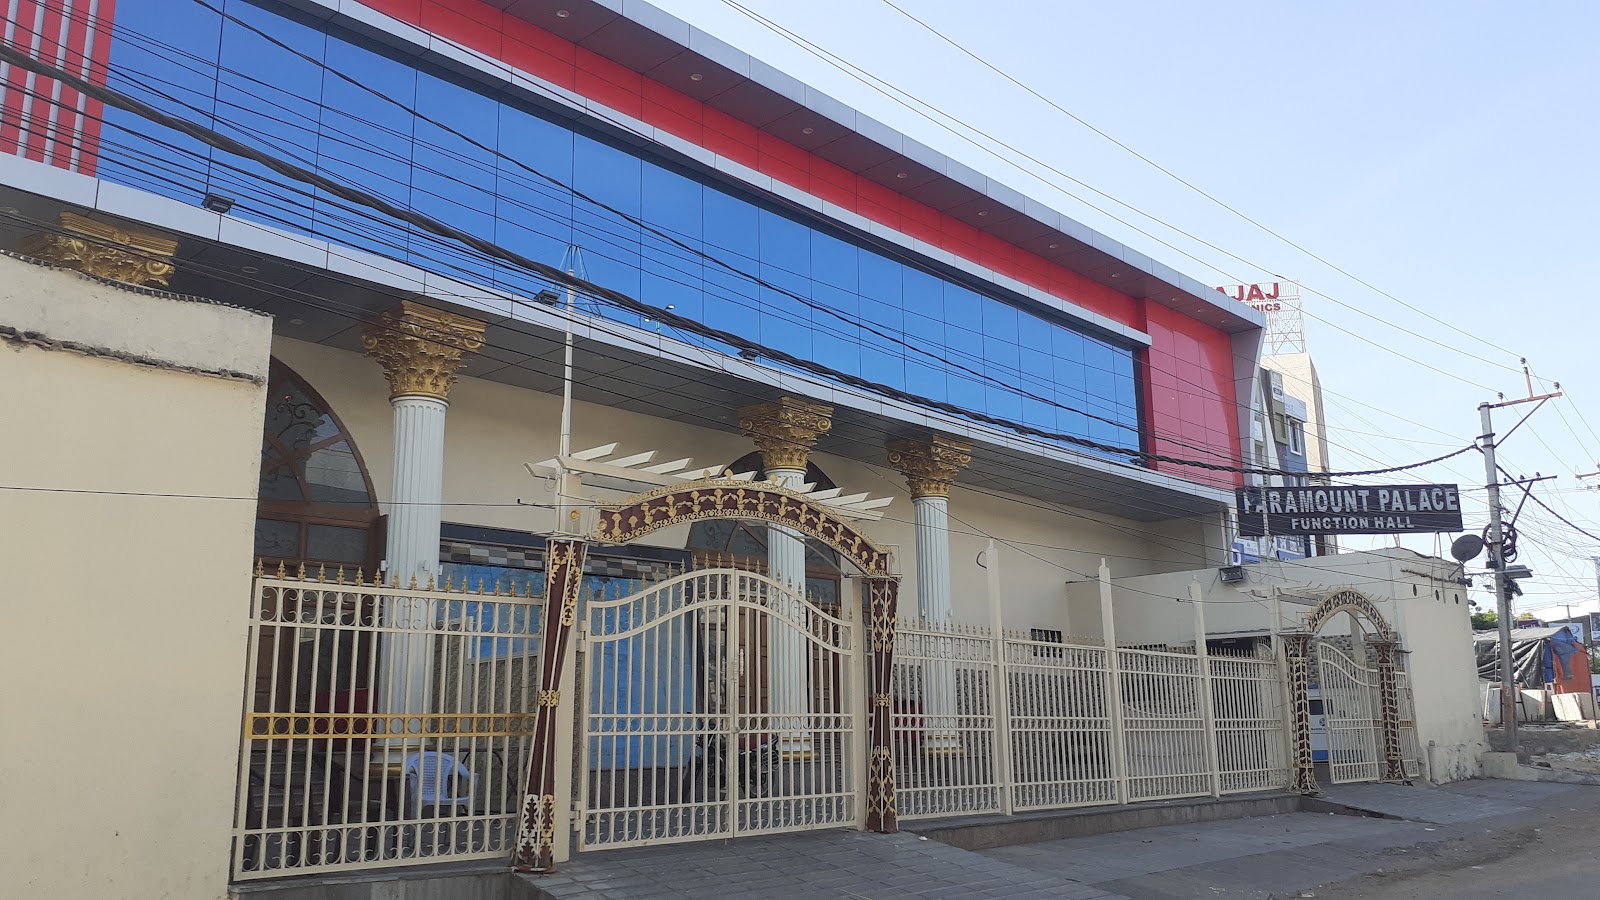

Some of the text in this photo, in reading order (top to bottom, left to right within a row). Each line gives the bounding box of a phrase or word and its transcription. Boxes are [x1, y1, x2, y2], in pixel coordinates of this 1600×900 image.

[1378, 488, 1458, 512] PALACE
[1291, 516, 1414, 530] FUNCTION HALL
